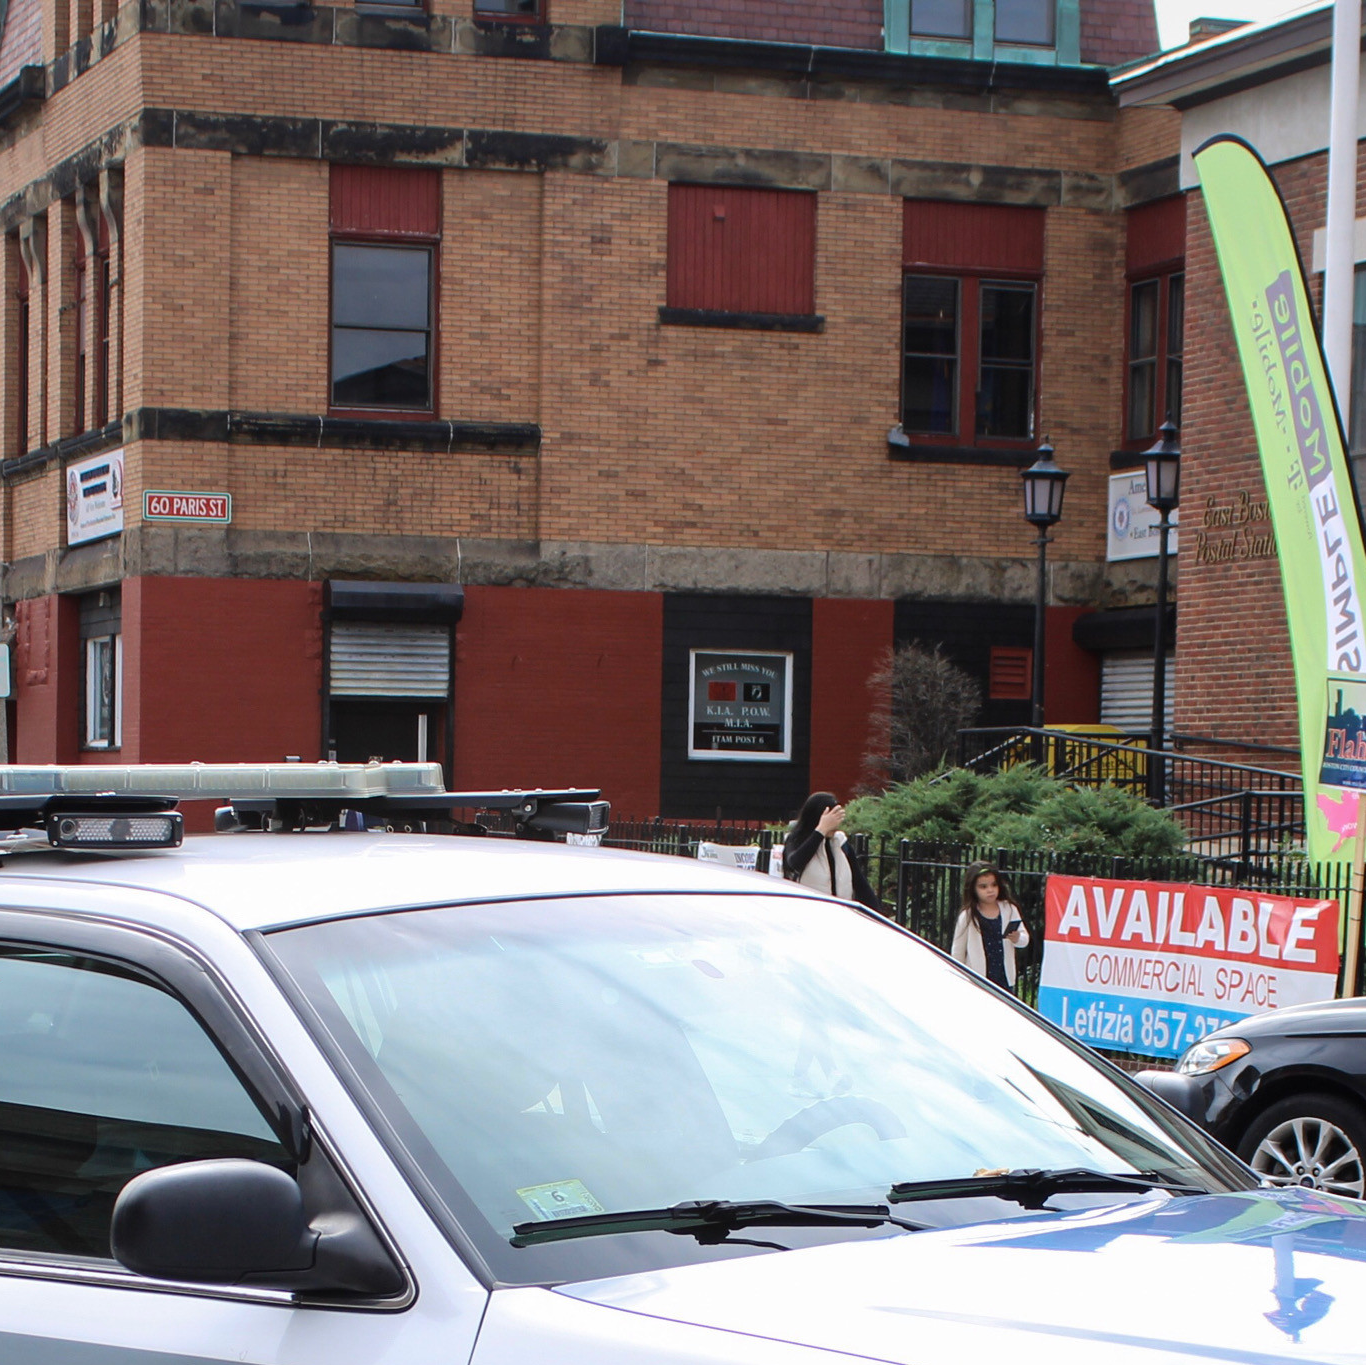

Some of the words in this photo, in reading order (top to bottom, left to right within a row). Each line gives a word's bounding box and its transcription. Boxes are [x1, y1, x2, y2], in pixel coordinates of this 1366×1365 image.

[150, 497, 170, 514] 60
[173, 498, 207, 516] PARIS
[1203, 494, 1234, 528] East
[1195, 532, 1236, 565] Postal
[701, 667, 715, 677] WE
[716, 662, 739, 672] STILL
[741, 662, 760, 673] MISS
[761, 668, 777, 680] YOU
[706, 706, 734, 716] K.I.A.
[741, 707, 771, 717] P.O.W.
[724, 718, 753, 728] M.I.A.
[735, 736, 756, 744] POST
[1057, 885, 1320, 963] AVAILABLE
[1085, 953, 1205, 997] COMMERCIAL
[1214, 967, 1278, 1008] SPACE
[1061, 996, 1134, 1043] Letizia
